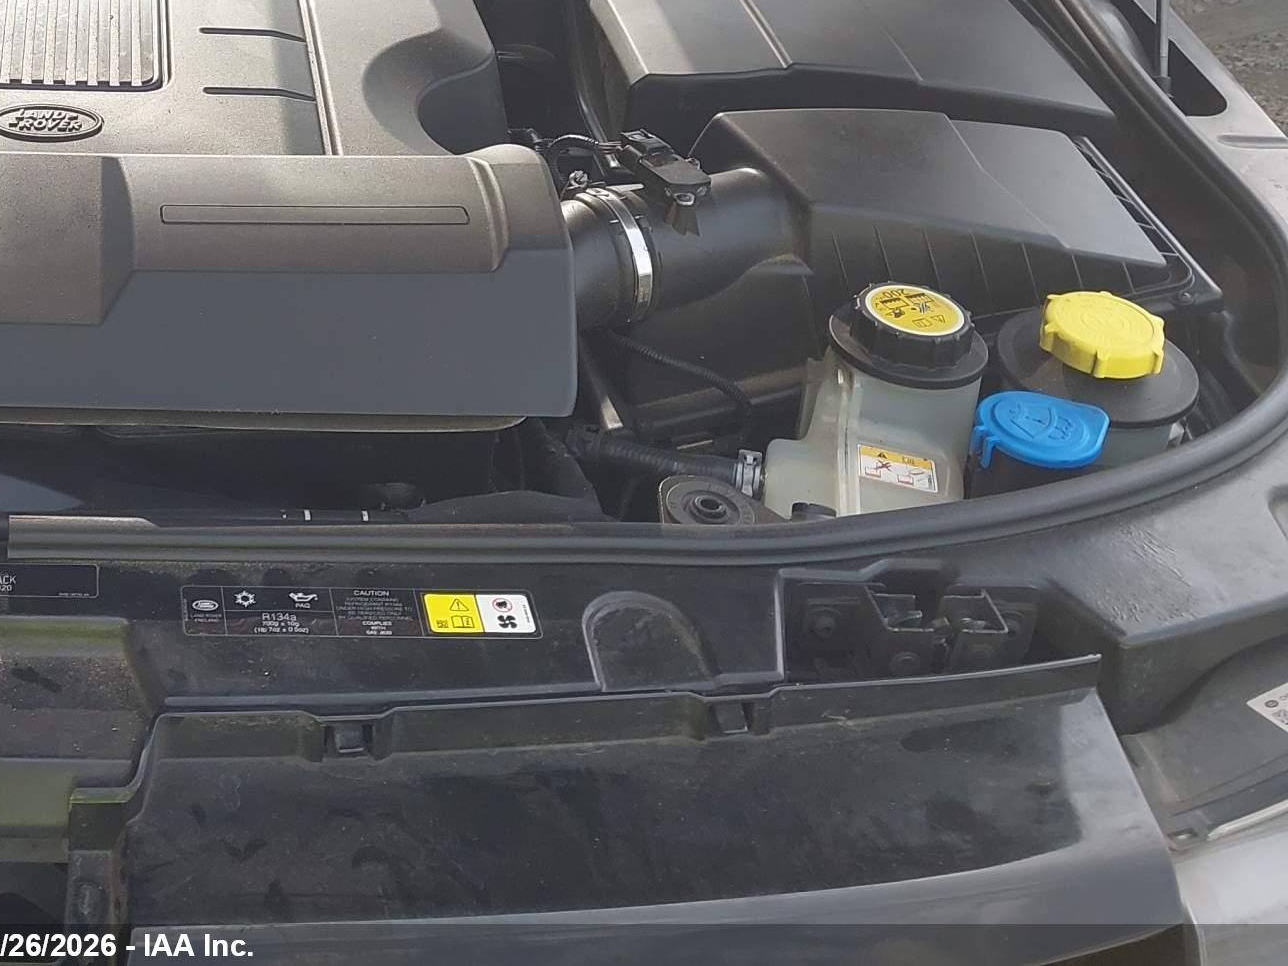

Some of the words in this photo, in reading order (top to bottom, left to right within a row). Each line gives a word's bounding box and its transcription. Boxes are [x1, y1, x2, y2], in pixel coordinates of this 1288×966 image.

[16, 109, 66, 120] LAND
[18, 118, 83, 132] ROVER
[262, 612, 297, 622] R134a
